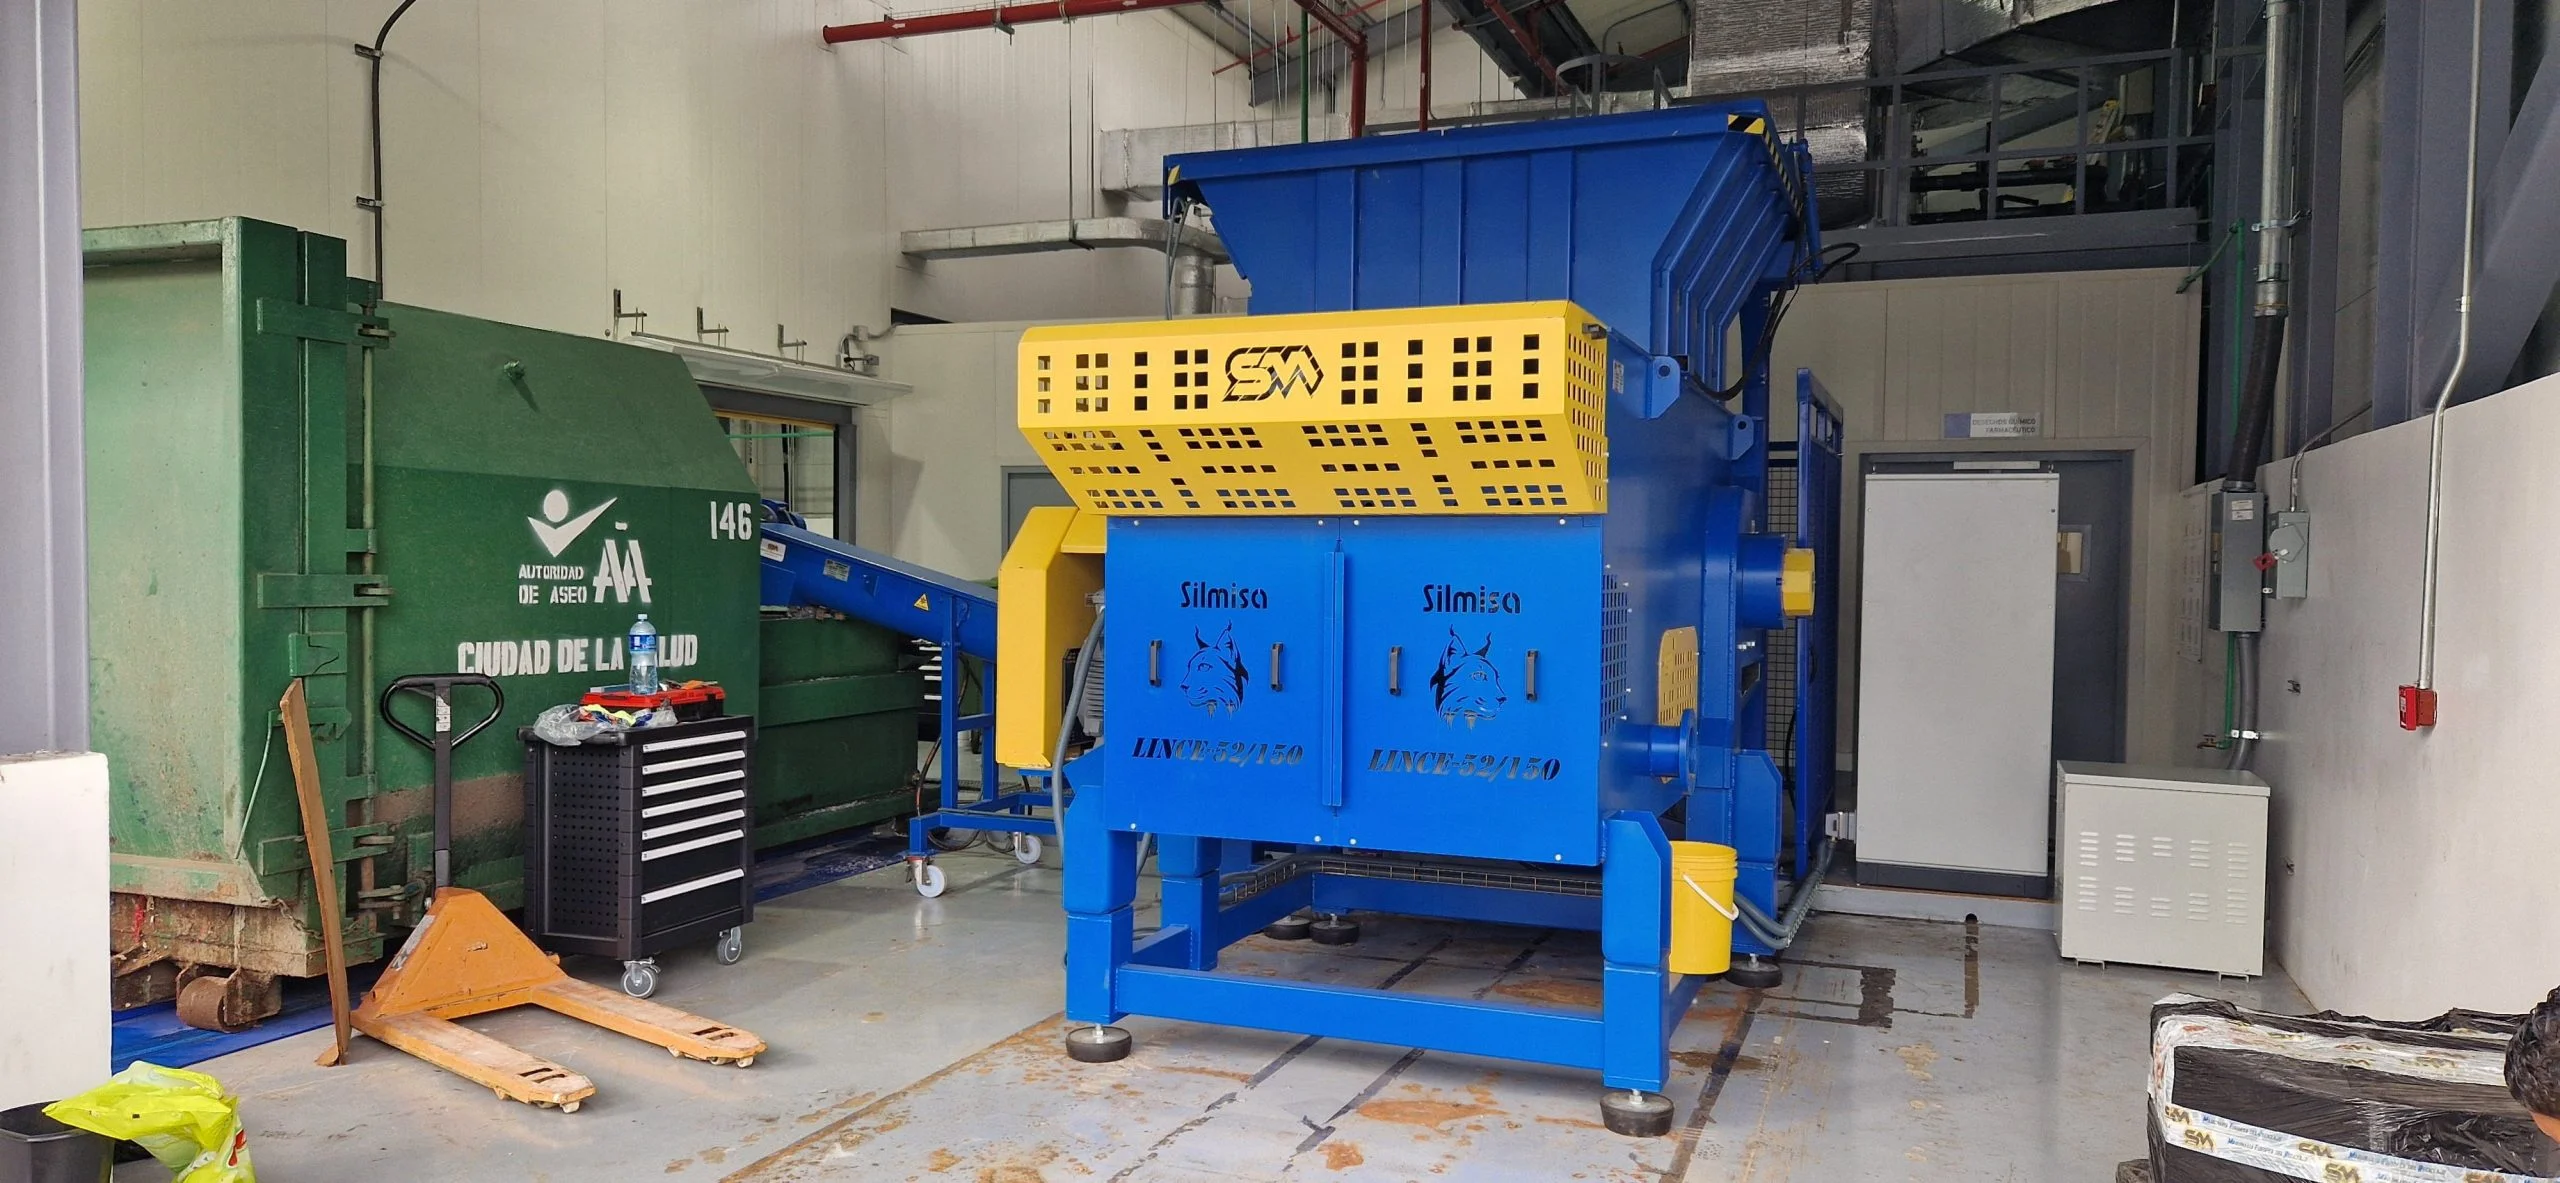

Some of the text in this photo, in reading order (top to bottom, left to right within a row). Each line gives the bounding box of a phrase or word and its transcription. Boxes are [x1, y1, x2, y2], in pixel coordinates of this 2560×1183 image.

[1221, 345, 1324, 402] SM
[710, 501, 752, 541] 146
[518, 564, 584, 580] AUTORIDAD
[518, 585, 587, 604] DE ASEO
[1180, 581, 1268, 609] Silmisa
[1422, 584, 1521, 614] Silmisa
[458, 640, 550, 677] CIUDAD
[557, 638, 589, 673] DE
[595, 637, 625, 672] LA
[1132, 737, 1304, 768] LINCE-52/150
[1368, 749, 1561, 782] LINCE-52/150
[2184, 1129, 2214, 1152] SM
